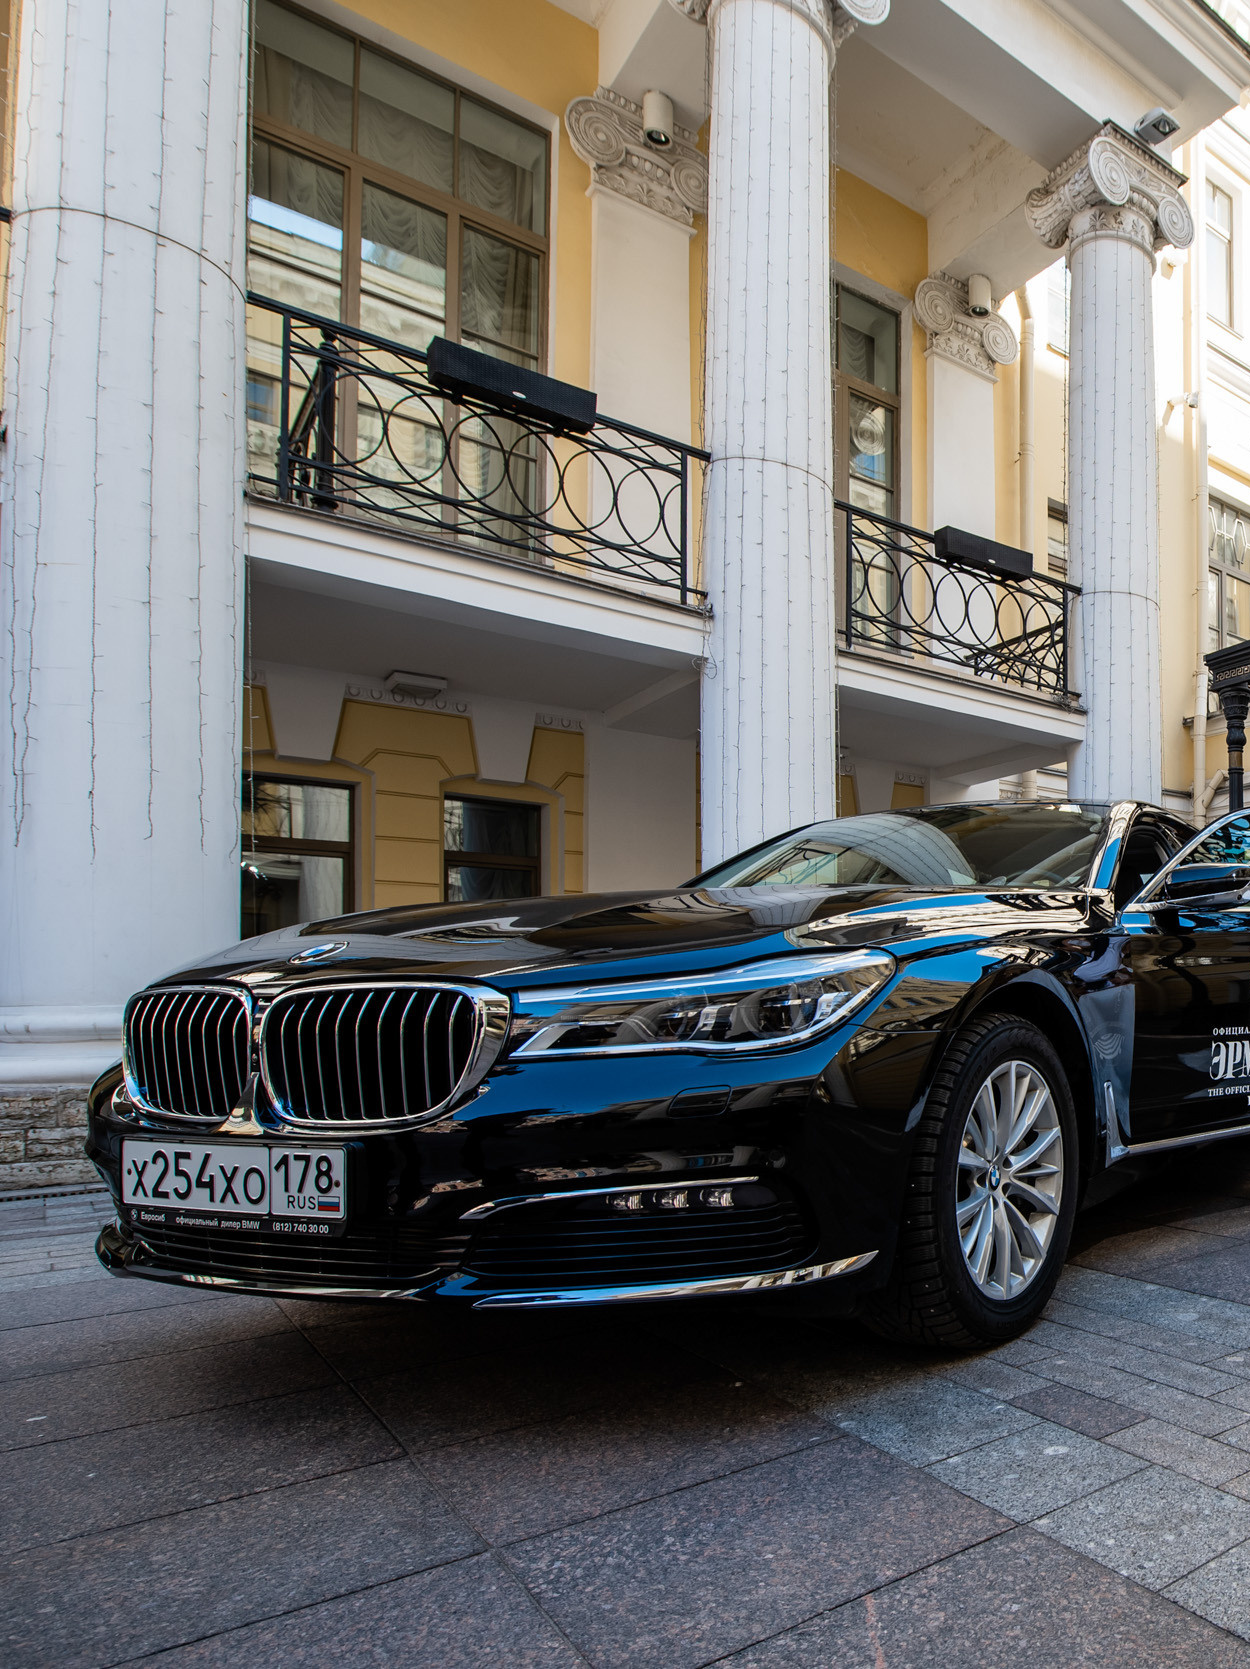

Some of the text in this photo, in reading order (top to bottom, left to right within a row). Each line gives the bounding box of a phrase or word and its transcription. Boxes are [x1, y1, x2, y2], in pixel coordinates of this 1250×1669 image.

[1207, 1087, 1225, 1097] THE
[274, 1152, 333, 1194] 178
[287, 1194, 317, 1210] RUS
[140, 1211, 329, 1234] Евросиб официальный дилер BMW (812) 740 30 00
